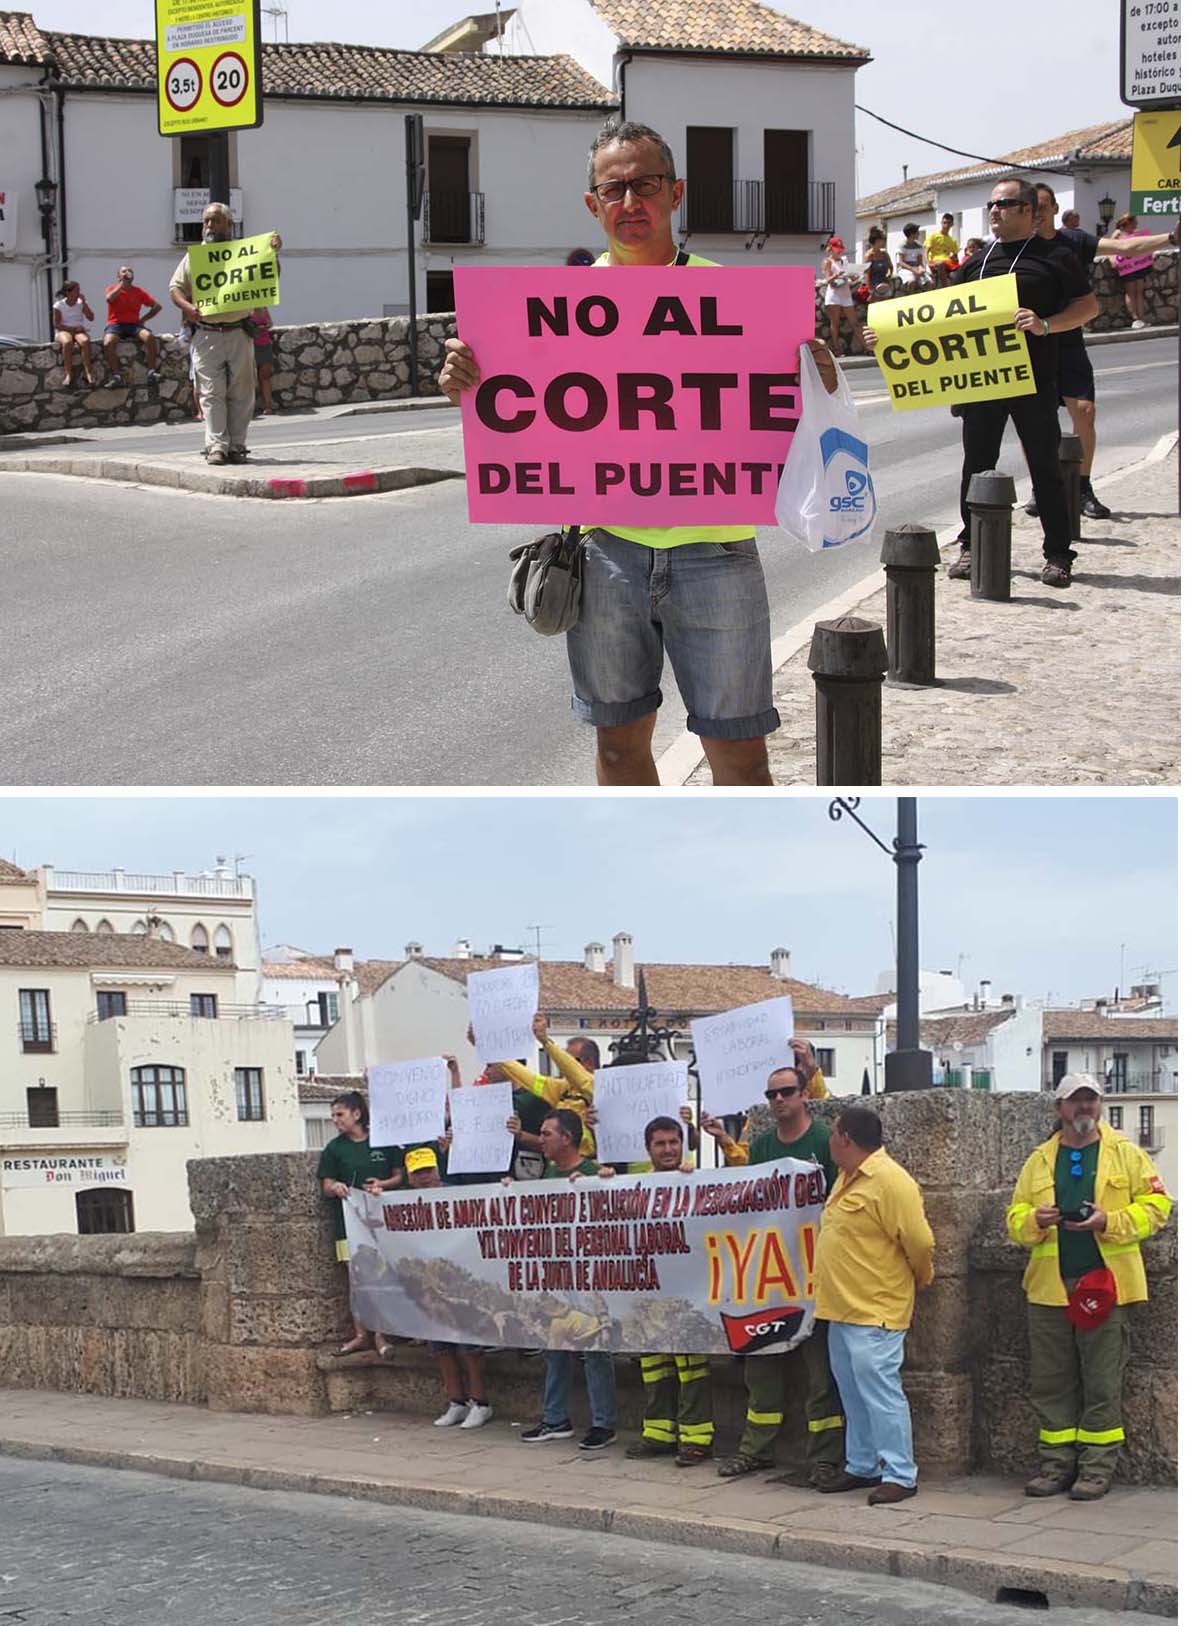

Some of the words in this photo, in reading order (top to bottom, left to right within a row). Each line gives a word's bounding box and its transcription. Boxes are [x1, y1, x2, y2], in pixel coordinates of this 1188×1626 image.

[1130, 6, 1141, 17] de
[1145, 2, 1169, 15] 17:00
[1173, 3, 1178, 11] a
[1141, 18, 1179, 31] excepto
[1141, 50, 1177, 63] hoteles
[171, 78, 196, 95] 3.5t
[217, 69, 241, 91] 20
[1131, 84, 1156, 96] Plaza
[208, 249, 232, 263] NO
[238, 244, 259, 258] AL
[195, 261, 275, 291] CORTE
[197, 295, 219, 309] DEL
[223, 286, 277, 303] PUENTE
[526, 295, 619, 337] NO
[642, 296, 743, 336] AL
[897, 304, 935, 327] NO
[945, 295, 987, 319] AL
[882, 323, 1021, 370] CORTE
[892, 379, 934, 399] DEL
[939, 364, 1031, 392] PUENTE
[475, 372, 801, 433] CORTE
[477, 462, 576, 495] DEL
[595, 462, 785, 497] PUENT
[829, 496, 864, 512] gsc
[4, 1158, 103, 1170] RESTAURANTE
[46, 1171, 72, 1182] Don
[80, 1168, 126, 1183] Miguel
[435, 1200, 451, 1230] DE
[453, 1198, 488, 1228] AMAYA
[489, 1197, 503, 1226] AL
[503, 1196, 516, 1226] VI
[520, 1191, 576, 1226] CONVENIO
[578, 1192, 588, 1223] E
[588, 1181, 651, 1222] INCLUSIÓN
[652, 1186, 672, 1219] EN
[671, 1185, 690, 1217] LA
[691, 1168, 791, 1217] NEGOCIACIÓN
[795, 1170, 825, 1209] DEL
[477, 1230, 497, 1259] VII
[498, 1228, 552, 1259] CONVENIO
[554, 1227, 573, 1258] DEL
[575, 1224, 632, 1258] PERSONAL
[634, 1221, 690, 1254] LABORAL
[509, 1261, 522, 1290] DE
[526, 1261, 540, 1290] LA
[542, 1261, 574, 1290] JUNTA
[576, 1260, 590, 1291] DE
[592, 1254, 660, 1291] ANDALUCÍA
[706, 1226, 815, 1303] ¡YA!
[744, 1320, 786, 1337] CGT
